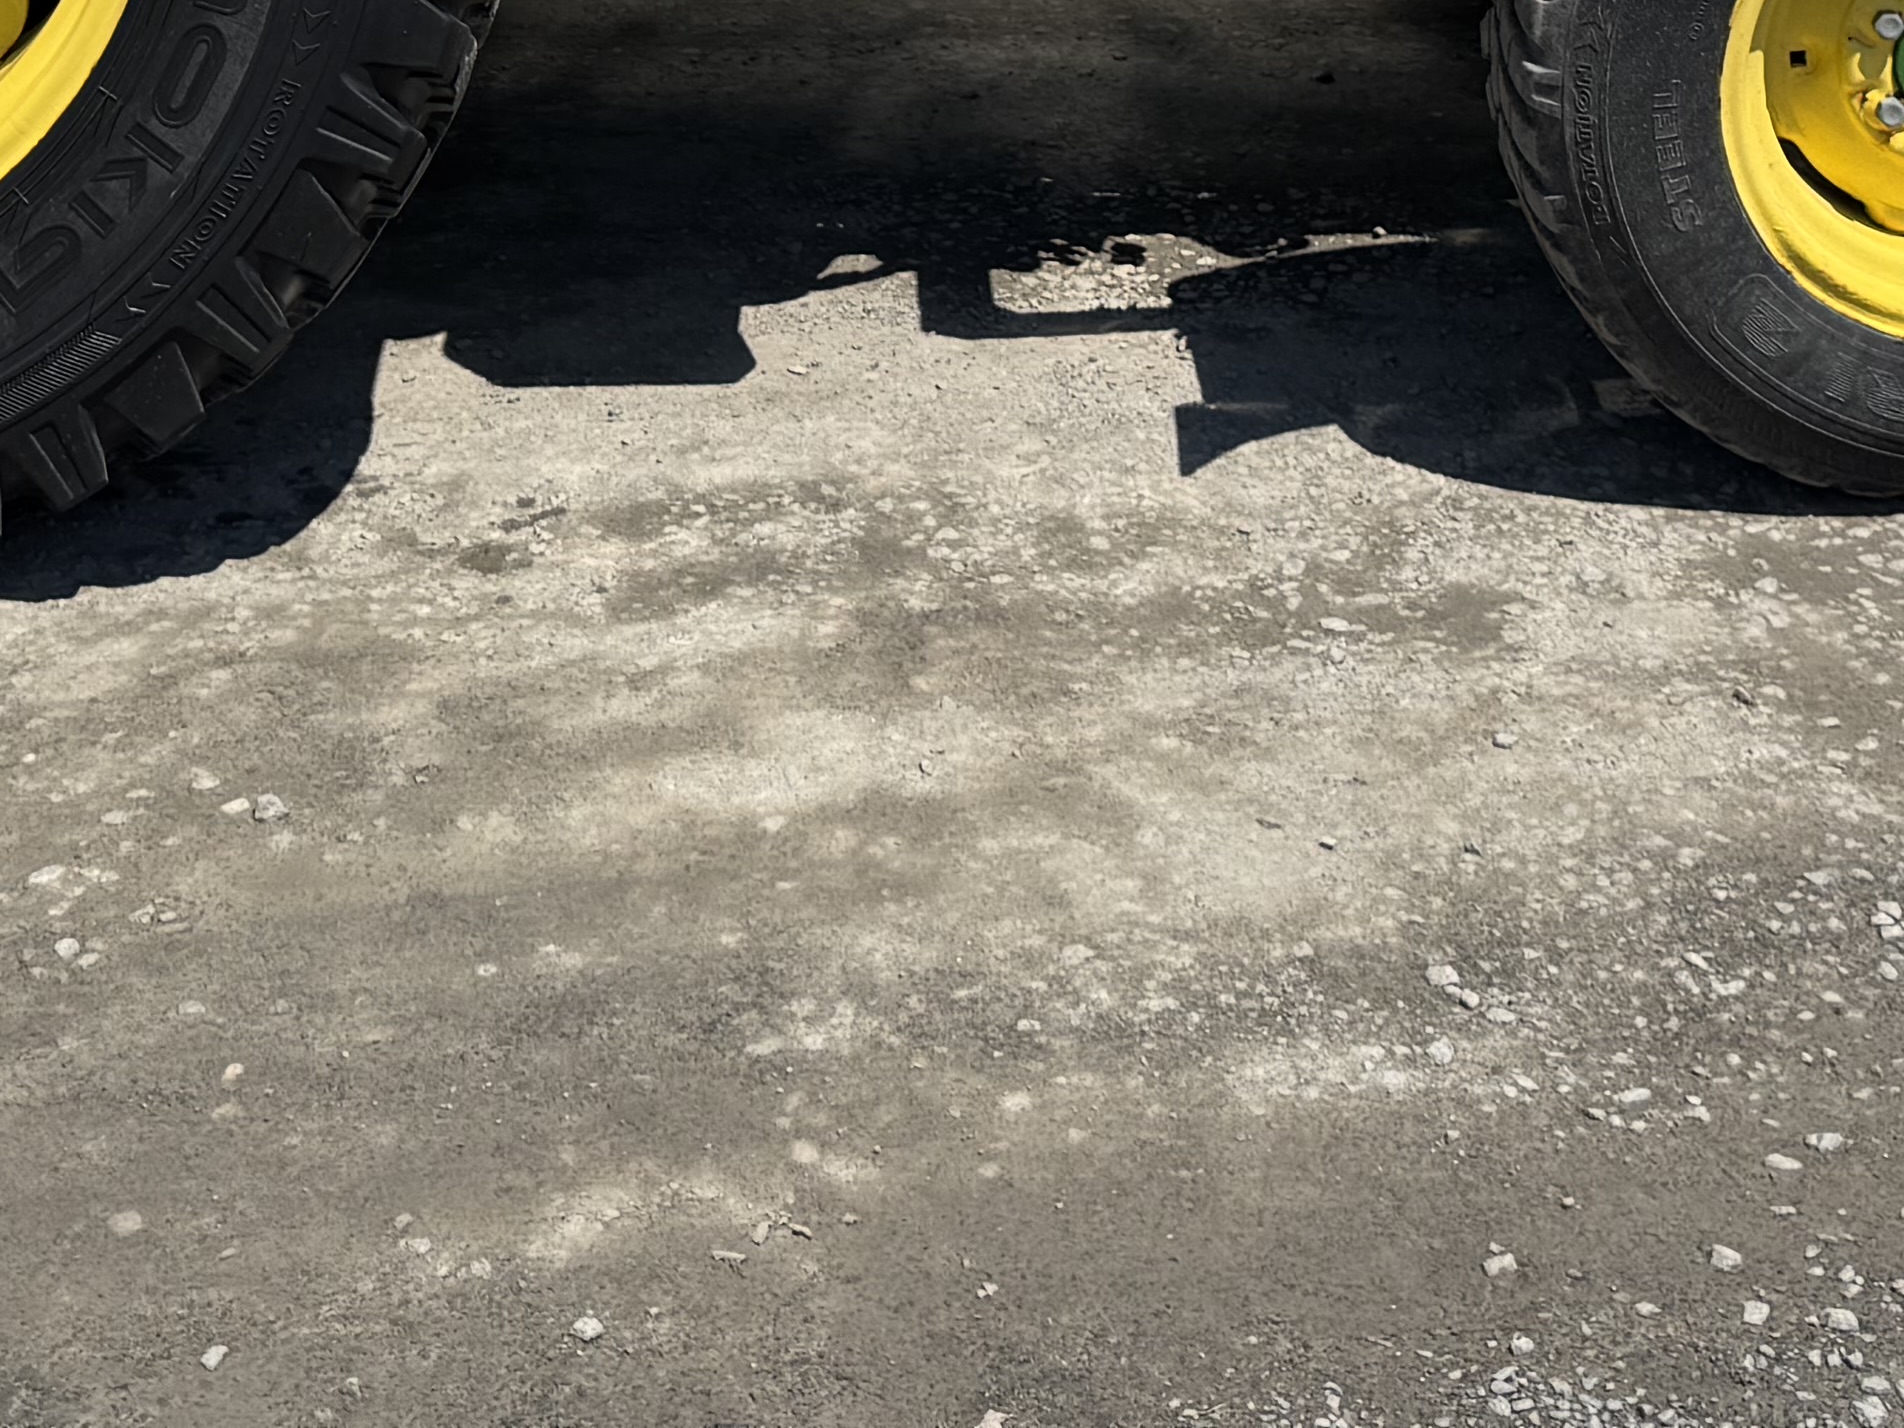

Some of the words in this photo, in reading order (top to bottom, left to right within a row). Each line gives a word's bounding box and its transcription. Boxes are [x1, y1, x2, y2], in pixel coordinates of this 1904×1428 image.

[168, 77, 302, 272] ROTATION
[1570, 62, 1612, 227] ROTATION
[1652, 89, 1703, 233] STEEL
[1741, 297, 1801, 358] 2
